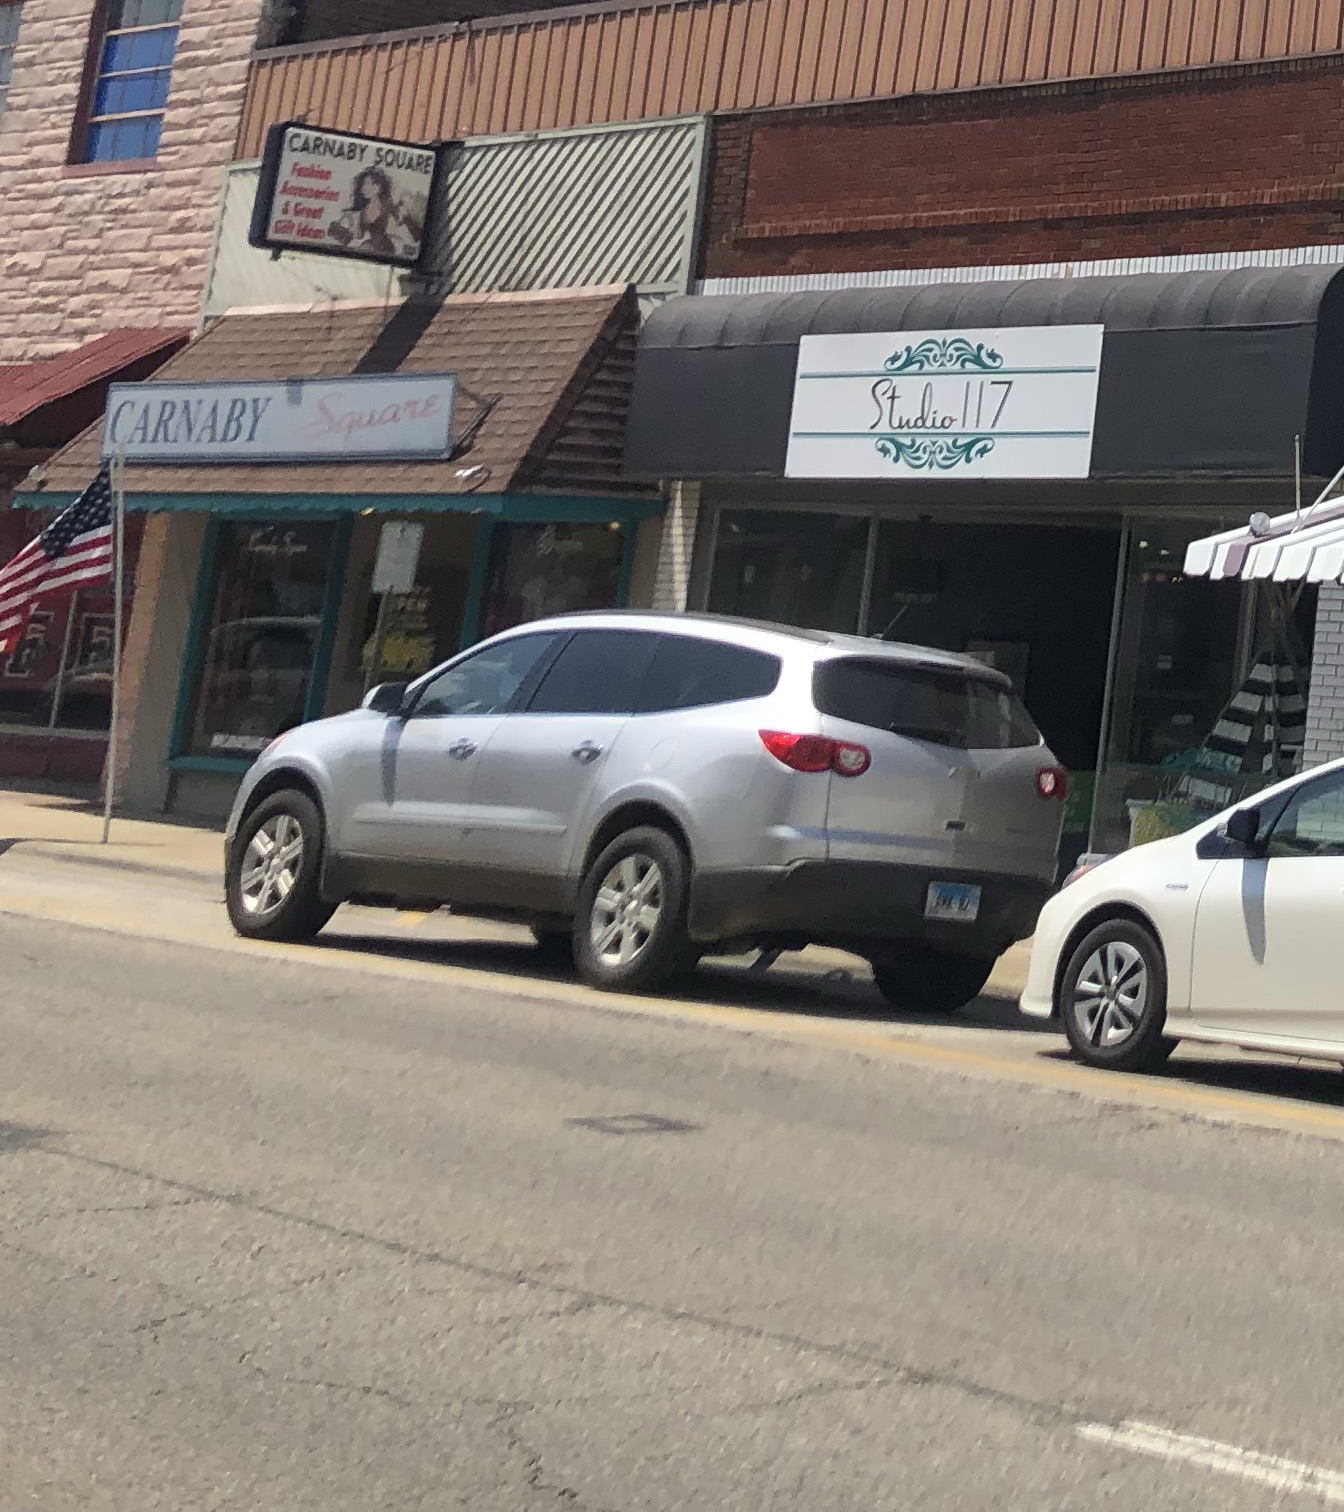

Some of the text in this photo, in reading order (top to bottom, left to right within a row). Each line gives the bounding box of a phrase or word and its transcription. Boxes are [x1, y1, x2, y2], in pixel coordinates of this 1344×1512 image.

[288, 133, 433, 175] CARNABY SQUARE
[109, 390, 441, 445] CARNABY Square
[869, 378, 1015, 430] Studio 117
